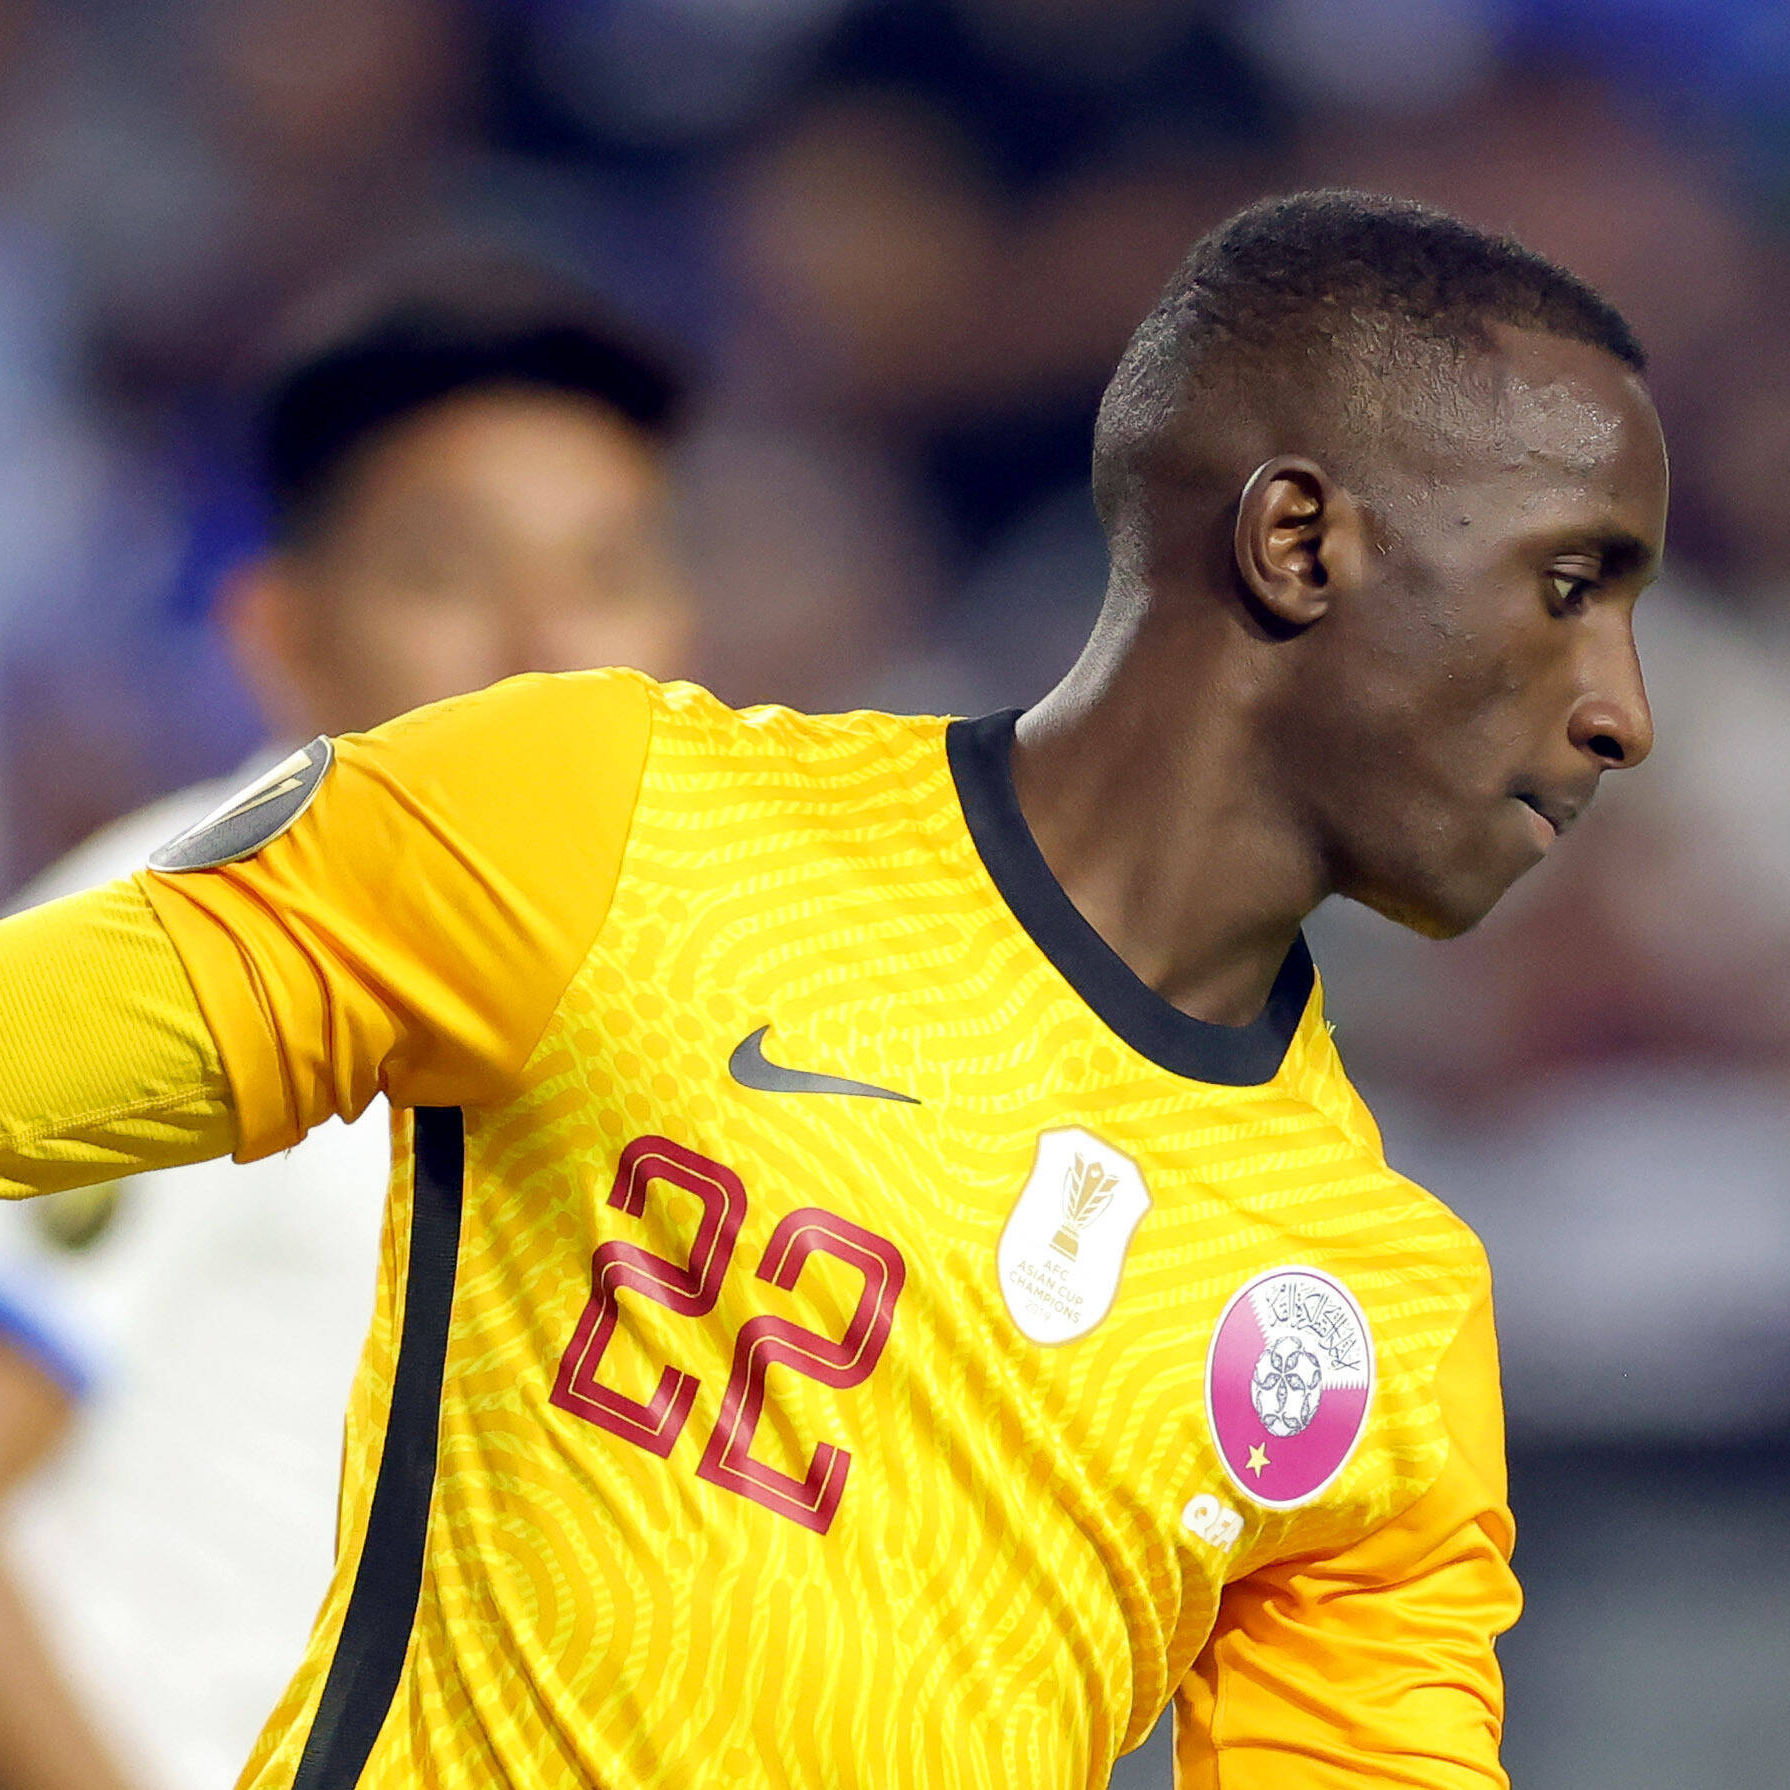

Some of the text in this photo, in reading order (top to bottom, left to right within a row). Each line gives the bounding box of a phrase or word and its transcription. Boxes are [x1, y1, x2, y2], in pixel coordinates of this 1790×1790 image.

[1009, 1270, 1082, 1324] CHAMPIONS
[1017, 1260, 1084, 1306] ASIAN CUP
[1043, 1260, 1069, 1281] AFC
[549, 1134, 906, 1536] 22
[1181, 1493, 1245, 1554] QFA
